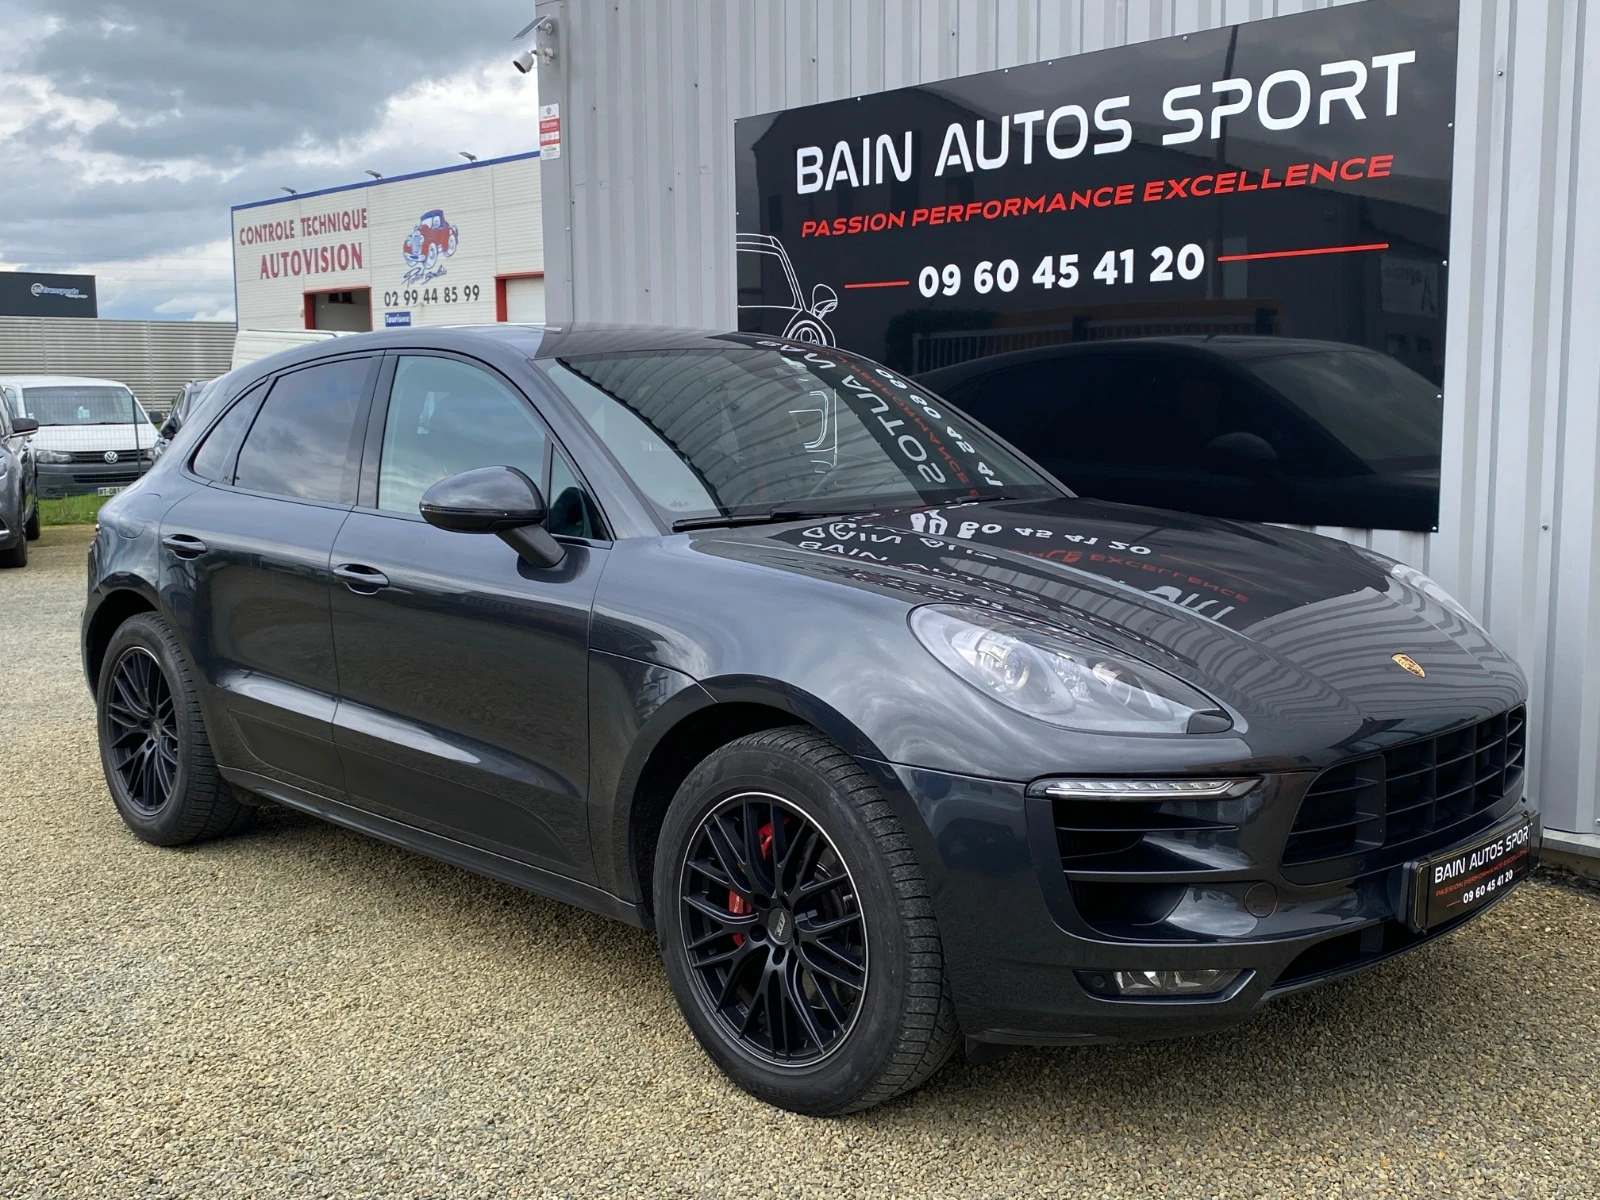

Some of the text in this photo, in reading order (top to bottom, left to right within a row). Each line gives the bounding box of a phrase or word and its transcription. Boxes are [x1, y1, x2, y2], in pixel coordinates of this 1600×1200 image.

[796, 50, 1416, 195] BAIN AUTOS SPORT
[801, 154, 1394, 238] PASSION PERFORMANCE EXCELLENCE
[239, 207, 368, 246] CONTROLE TECHNIQUE
[260, 242, 363, 280] AUTOVISION
[918, 243, 1205, 298] 09 60 45 41 20
[384, 284, 480, 307] 02 99 44 85 99
[385, 313, 410, 324] Tourisme
[1434, 822, 1533, 884] BAIN AUTOS SPOR
[1463, 869, 1514, 904] 09 60 45 41 20
